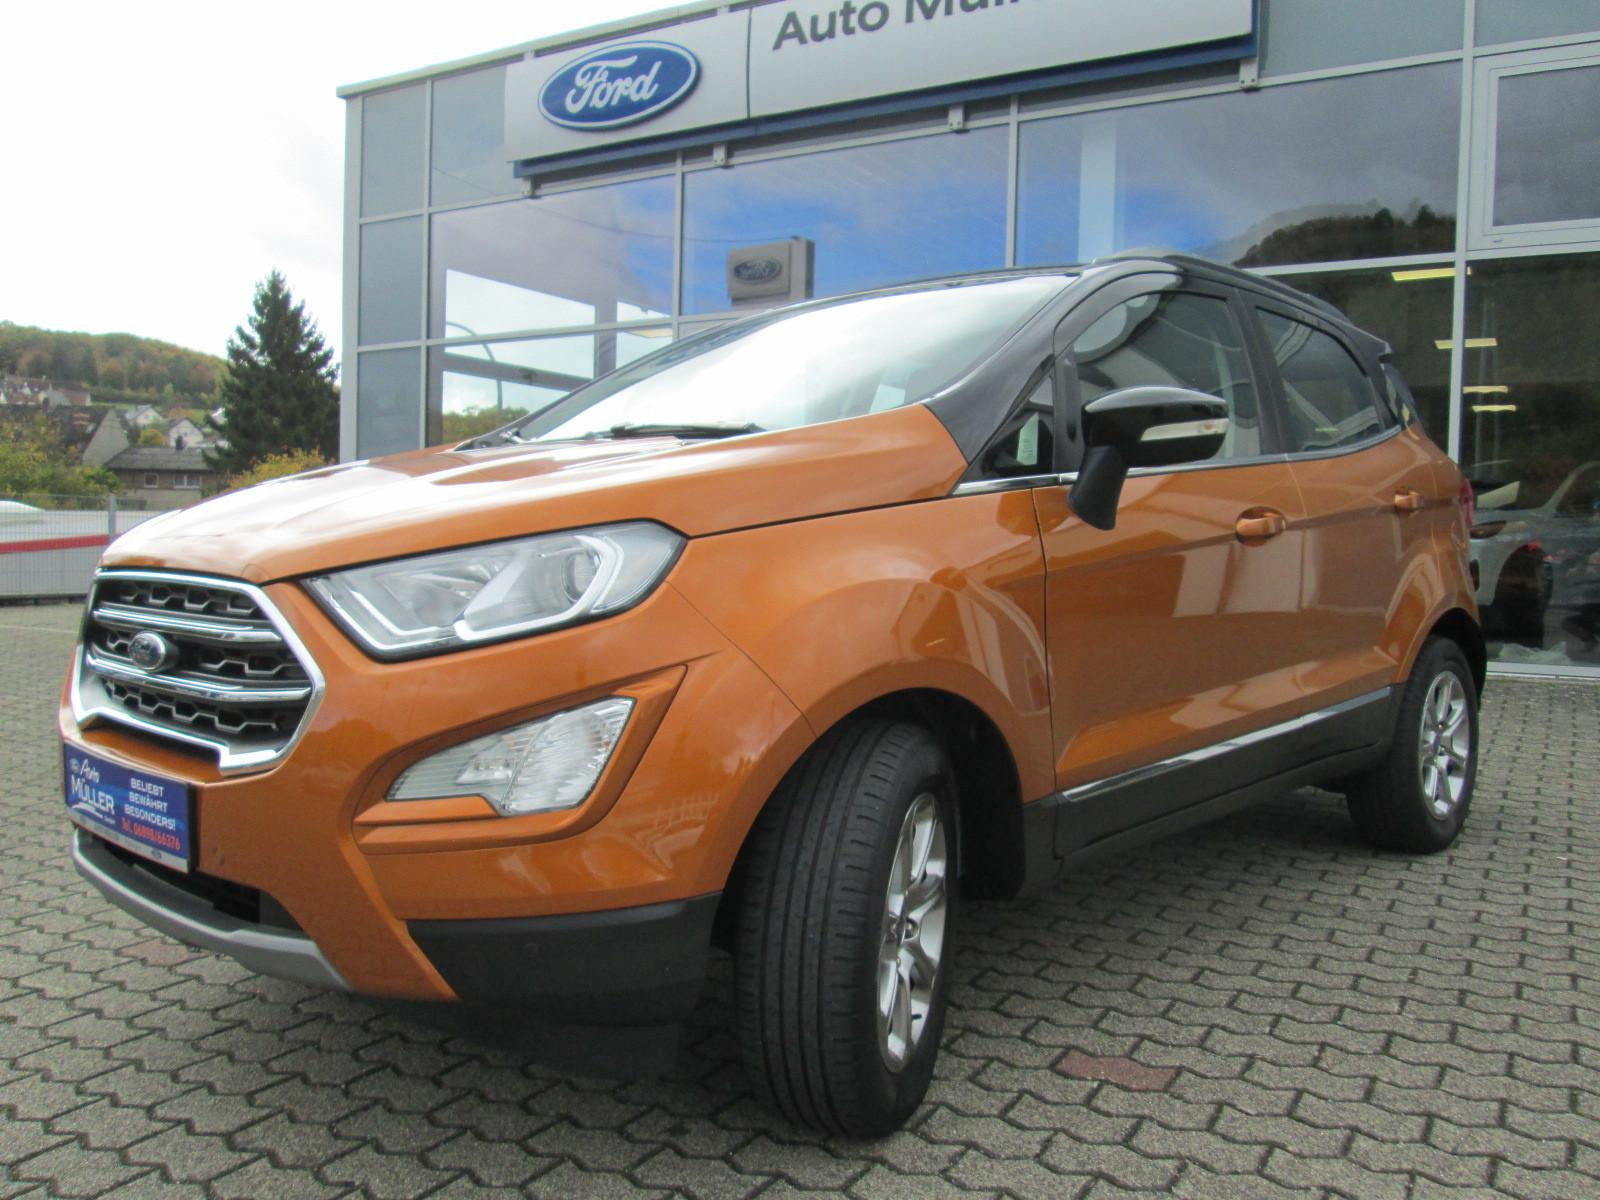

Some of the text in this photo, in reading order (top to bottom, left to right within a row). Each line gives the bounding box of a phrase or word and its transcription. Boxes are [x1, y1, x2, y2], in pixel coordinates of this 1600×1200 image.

[772, 0, 890, 51] Auto
[565, 55, 662, 114] Ford
[71, 774, 116, 816] MÜLLER
[128, 791, 169, 814] BEWÄHRT
[130, 777, 165, 798] BELIEBT
[123, 803, 177, 832] BESONDERS!
